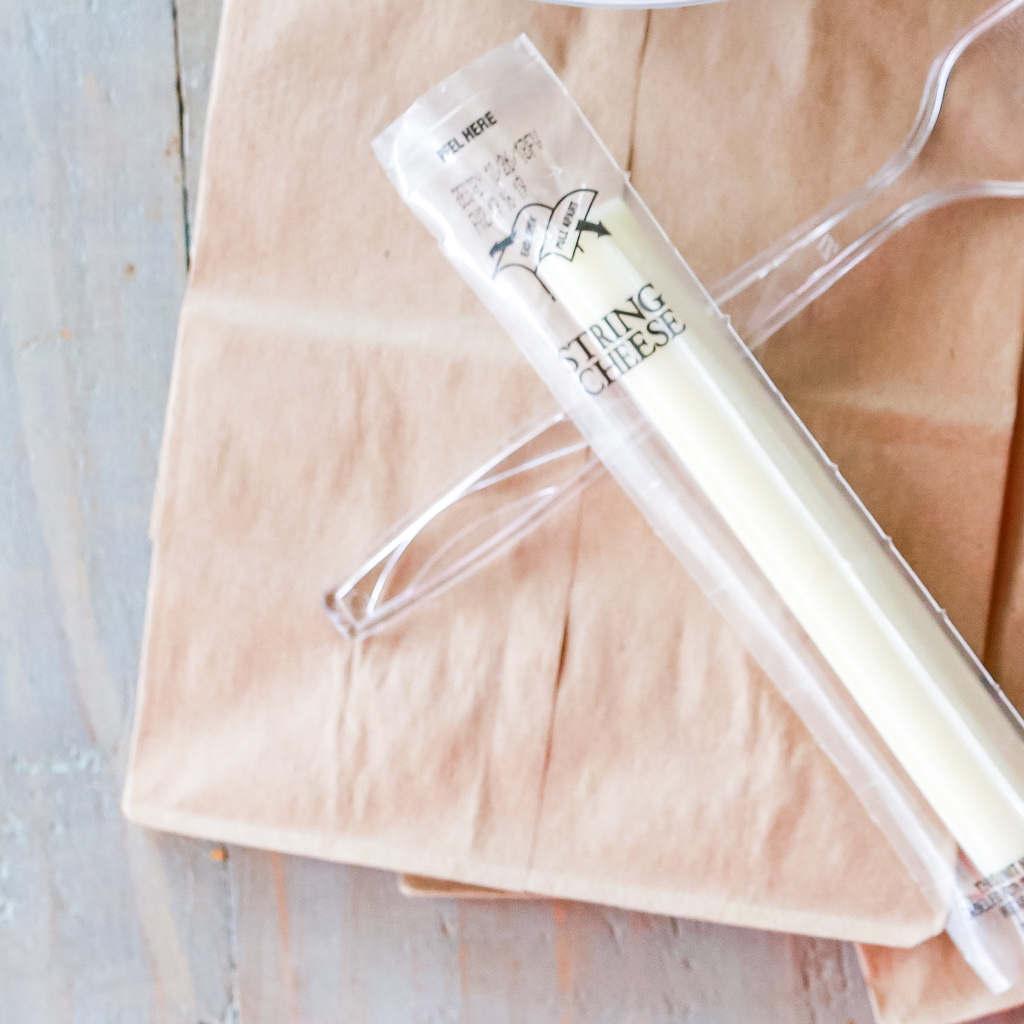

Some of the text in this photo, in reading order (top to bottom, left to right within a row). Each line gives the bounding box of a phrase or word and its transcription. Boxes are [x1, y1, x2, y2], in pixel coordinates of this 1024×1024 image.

[462, 111, 498, 143] HERE
[558, 283, 667, 372] STRING
[578, 309, 687, 396] CHEESE
